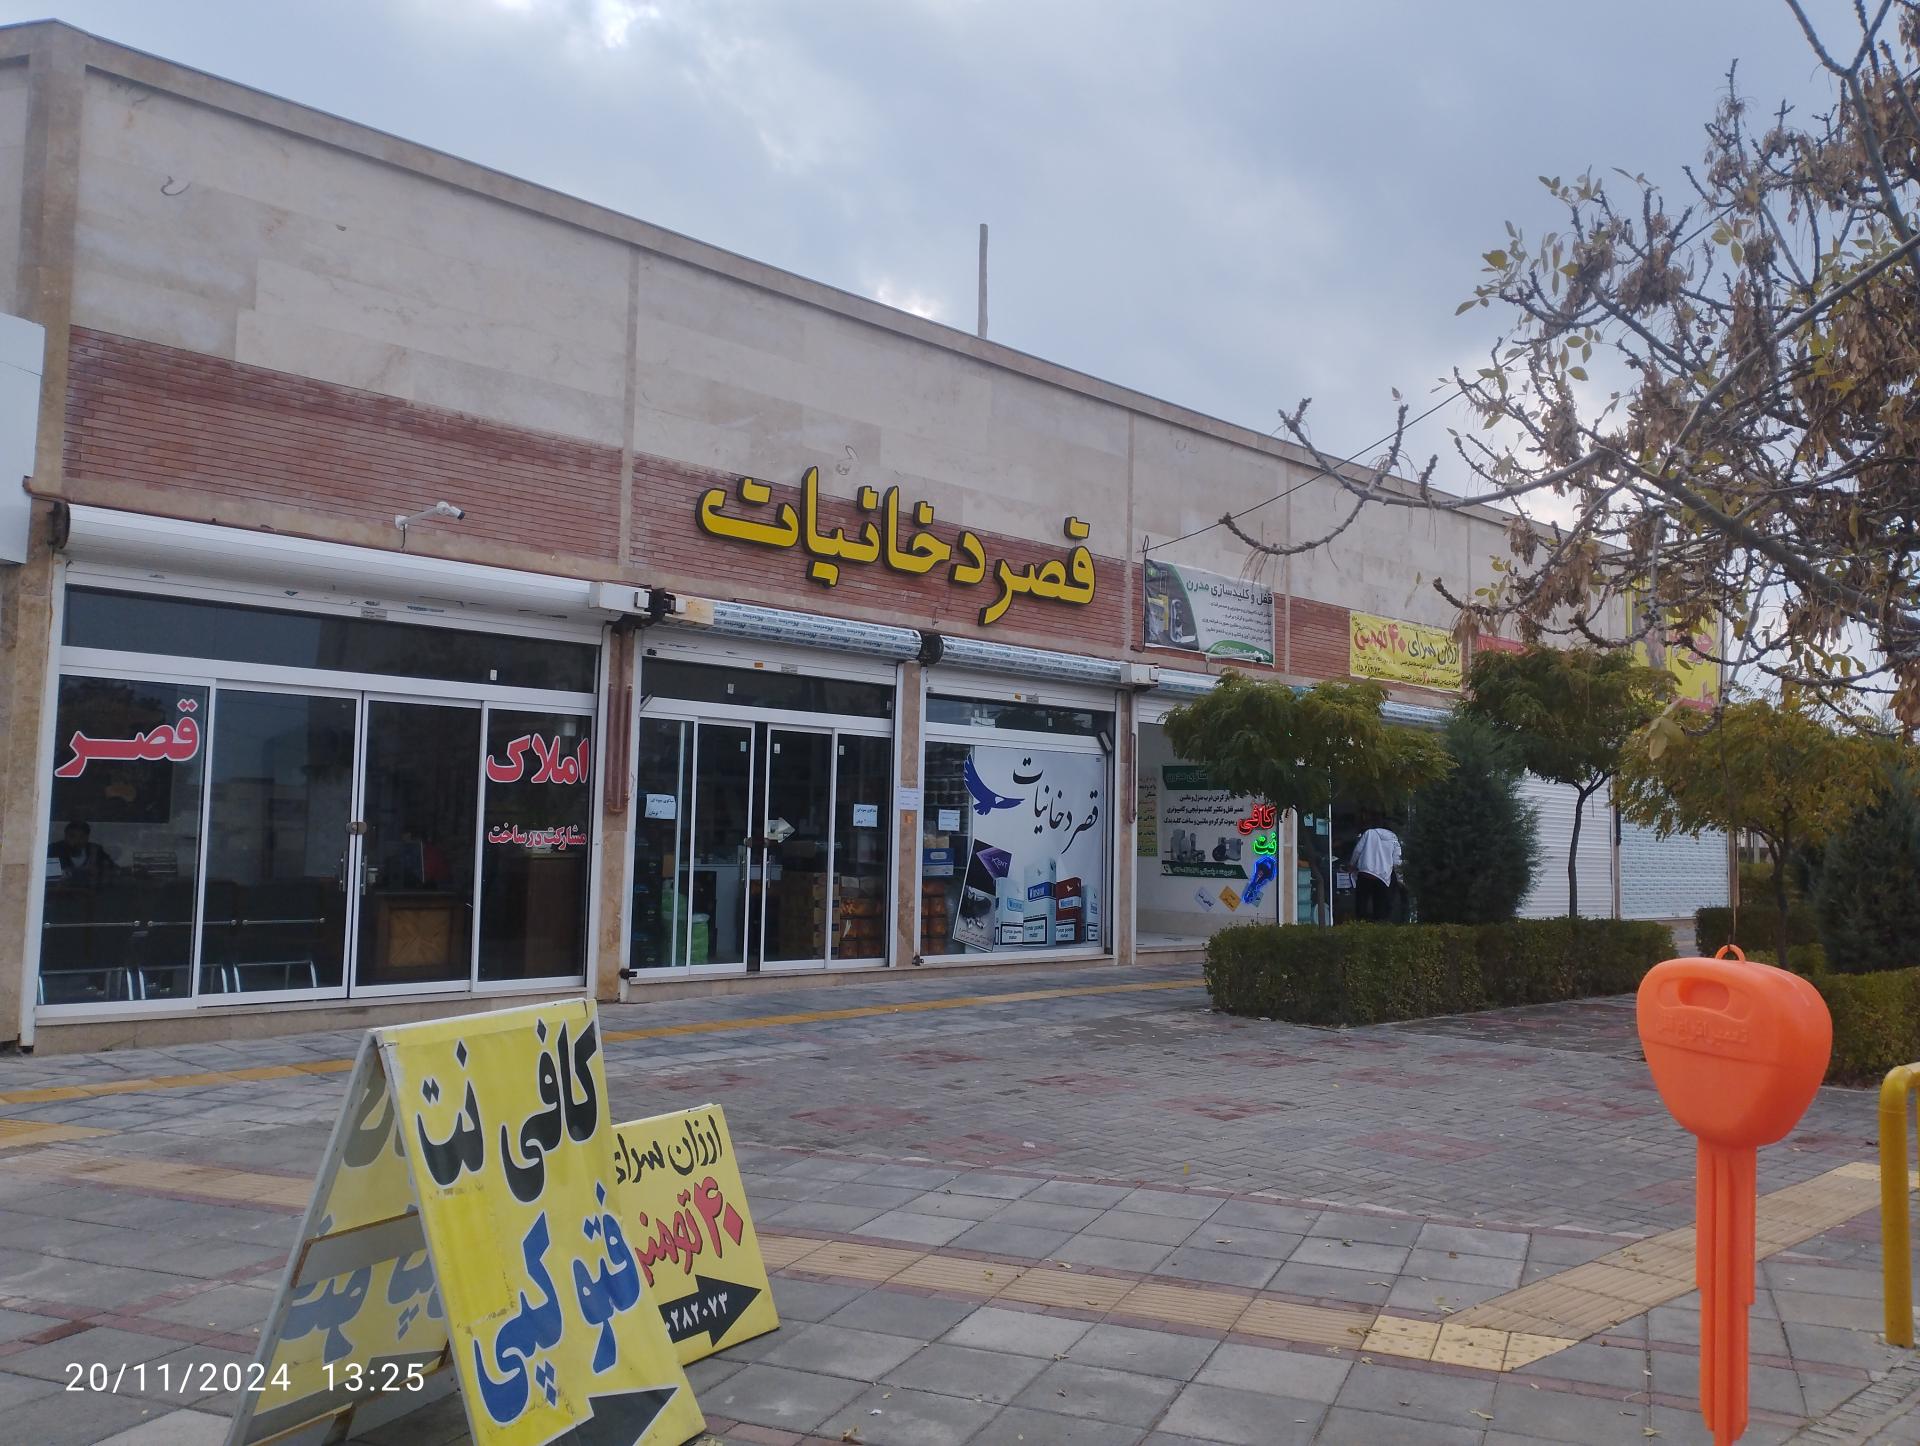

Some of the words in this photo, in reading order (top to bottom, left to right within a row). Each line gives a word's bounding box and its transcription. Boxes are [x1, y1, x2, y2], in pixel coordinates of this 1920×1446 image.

[696, 465, 986, 589] دخانیات
[978, 516, 1097, 626] قصر
[1257, 592, 1273, 606] قفل
[1407, 631, 1436, 660] سرای
[54, 699, 200, 777] قصر
[486, 734, 590, 785] املاک
[1013, 757, 1073, 835] دخانیات
[1061, 790, 1099, 855] قصر
[1239, 805, 1276, 835] کافی
[488, 822, 527, 844] ساخت
[525, 831, 543, 848] در
[543, 824, 587, 851] مشارکت
[1253, 832, 1276, 855] نت
[416, 1040, 485, 1187] نت
[500, 1018, 598, 1203] کافی
[668, 1114, 723, 1176] ارزان
[693, 1176, 744, 1259] ۴۰
[666, 1291, 728, 1333] ۰۲۸۲۰۷۳
